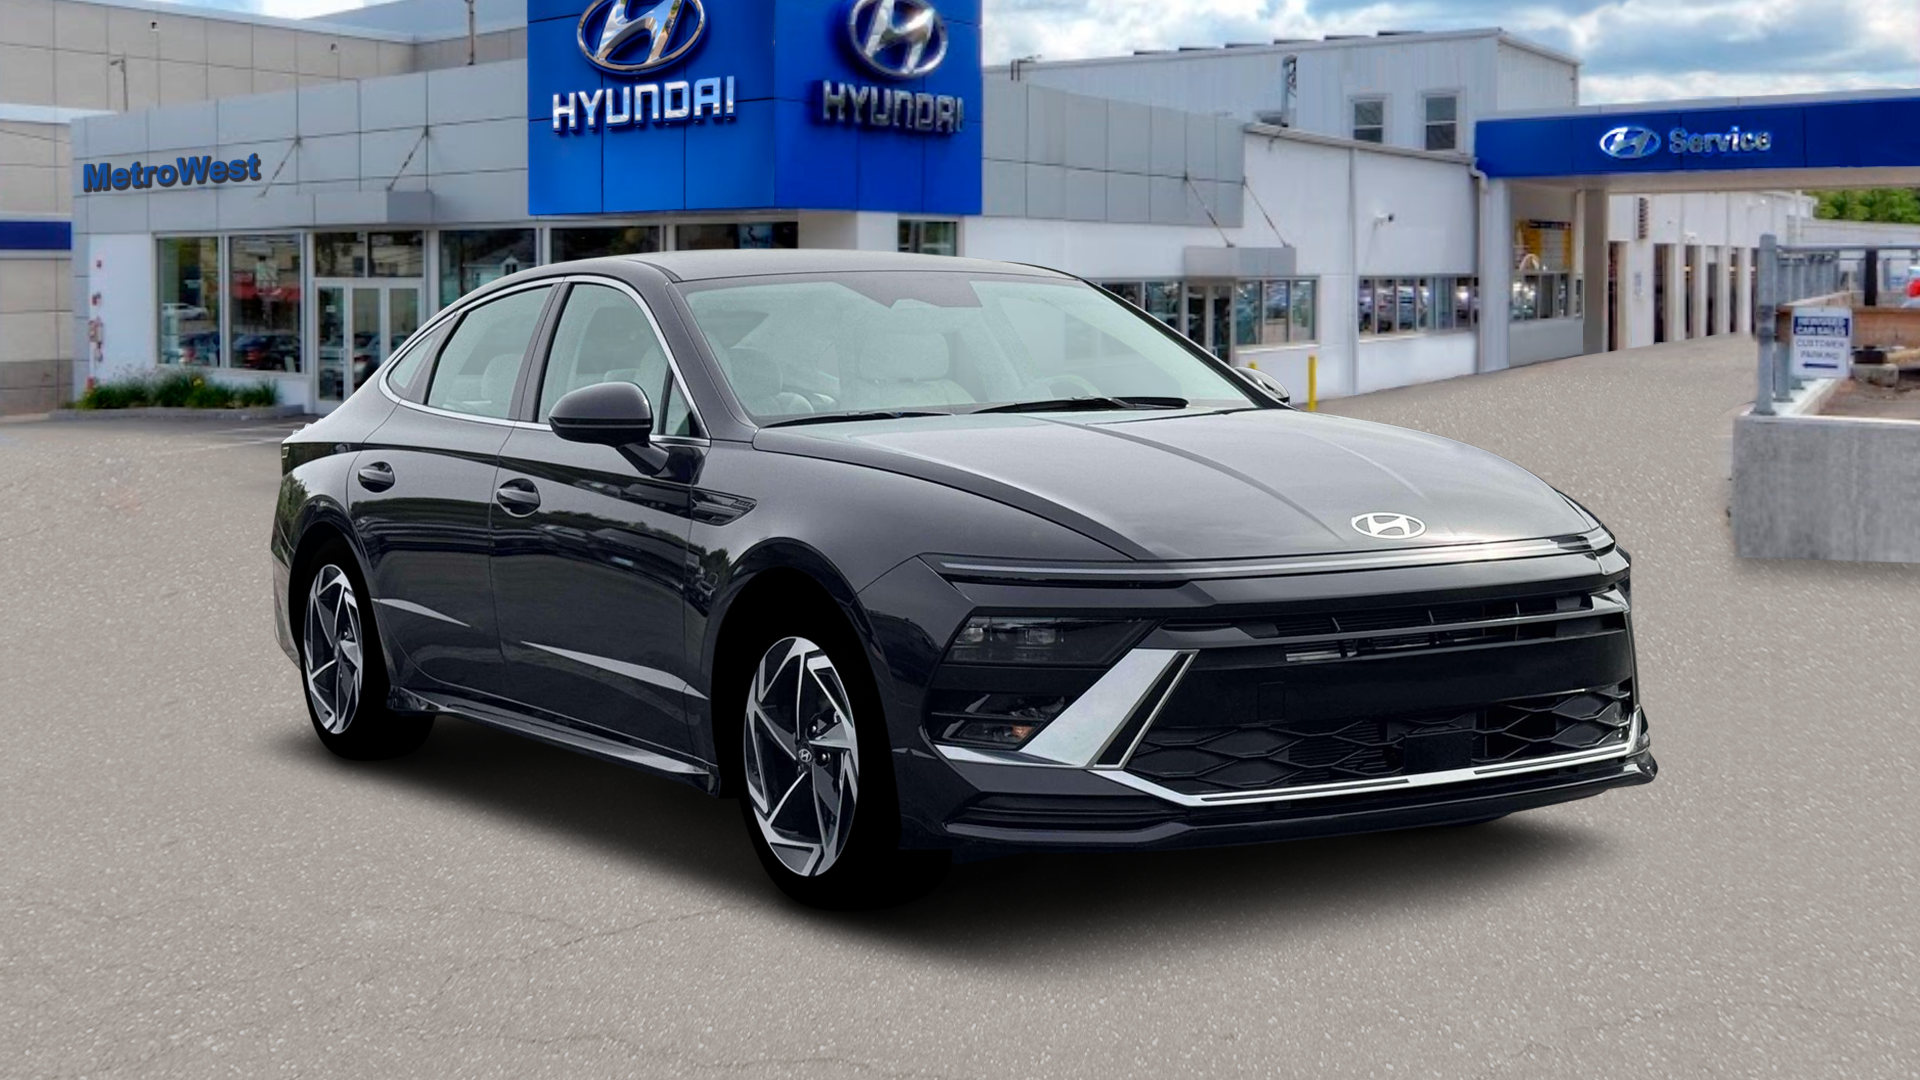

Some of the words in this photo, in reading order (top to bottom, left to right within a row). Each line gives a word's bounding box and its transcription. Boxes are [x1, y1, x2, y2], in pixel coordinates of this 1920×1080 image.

[553, 76, 735, 130] HYUNDAI
[823, 80, 965, 133] HYUNDAI
[1669, 125, 1772, 154] Service
[83, 153, 262, 193] MetroWest
